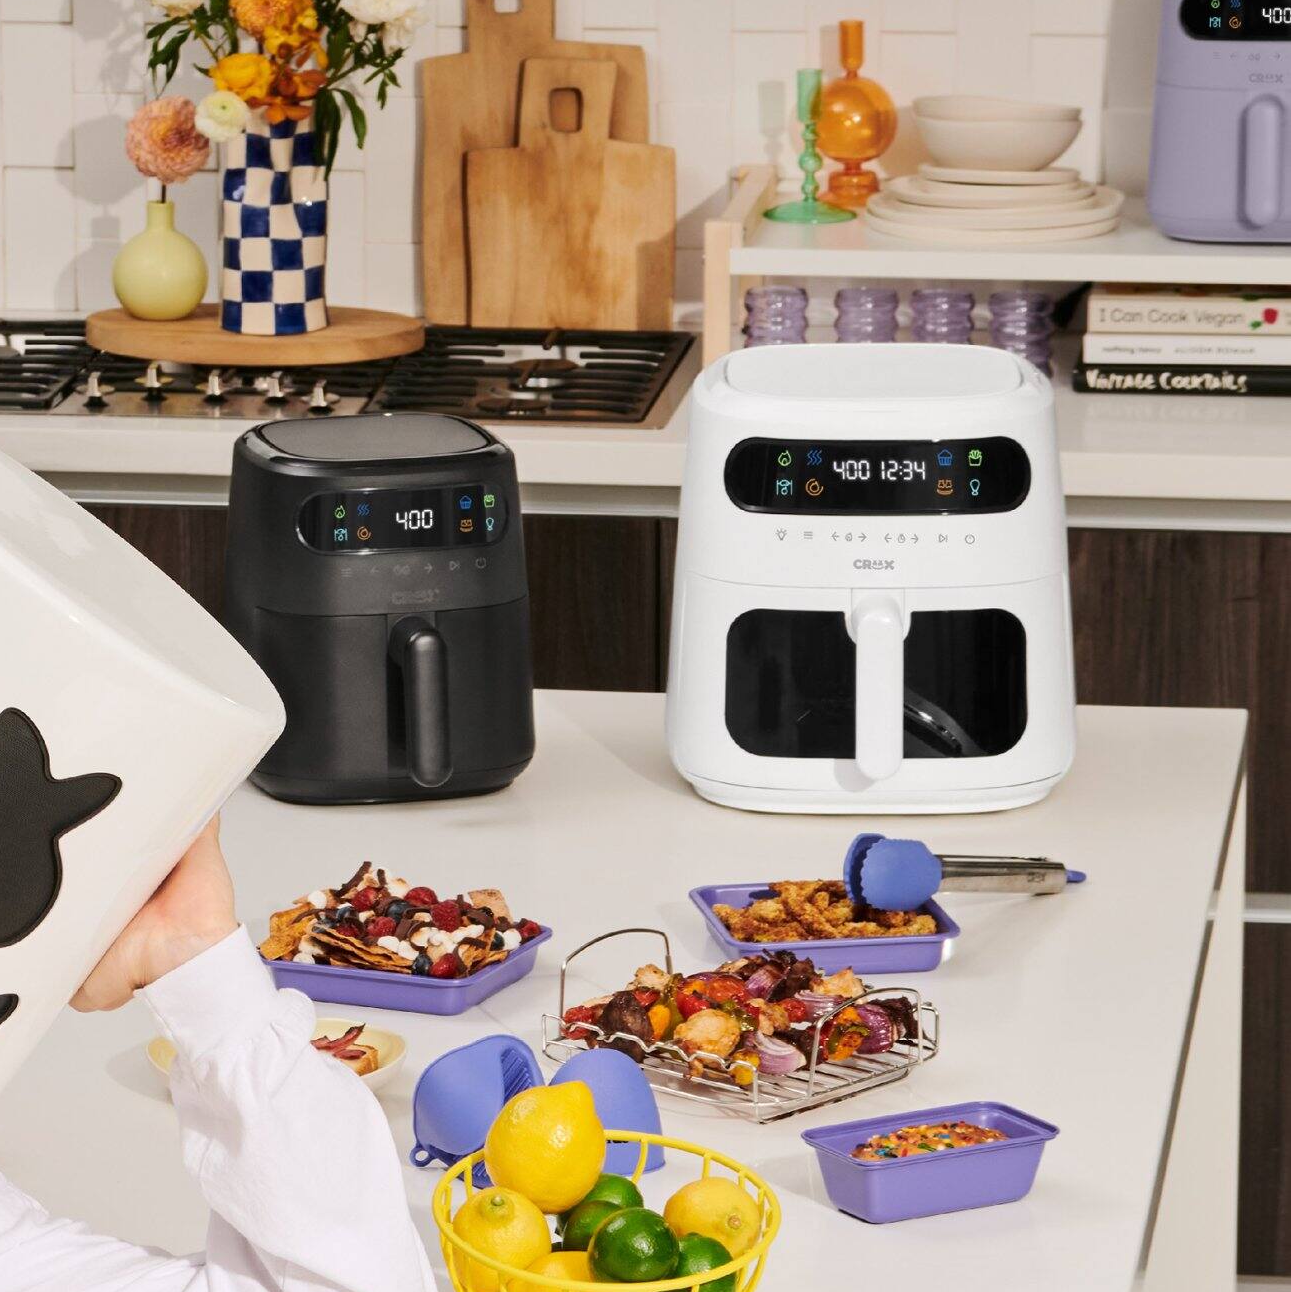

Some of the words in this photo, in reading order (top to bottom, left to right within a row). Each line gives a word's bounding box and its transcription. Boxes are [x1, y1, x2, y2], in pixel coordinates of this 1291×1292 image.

[1262, 7, 1291, 24] 400
[1110, 308, 1143, 324] Can
[1147, 308, 1189, 324] Cook
[1195, 309, 1246, 327] Vegan
[833, 460, 870, 480] 400
[879, 460, 926, 480] 12:34
[395, 509, 433, 531] 400
